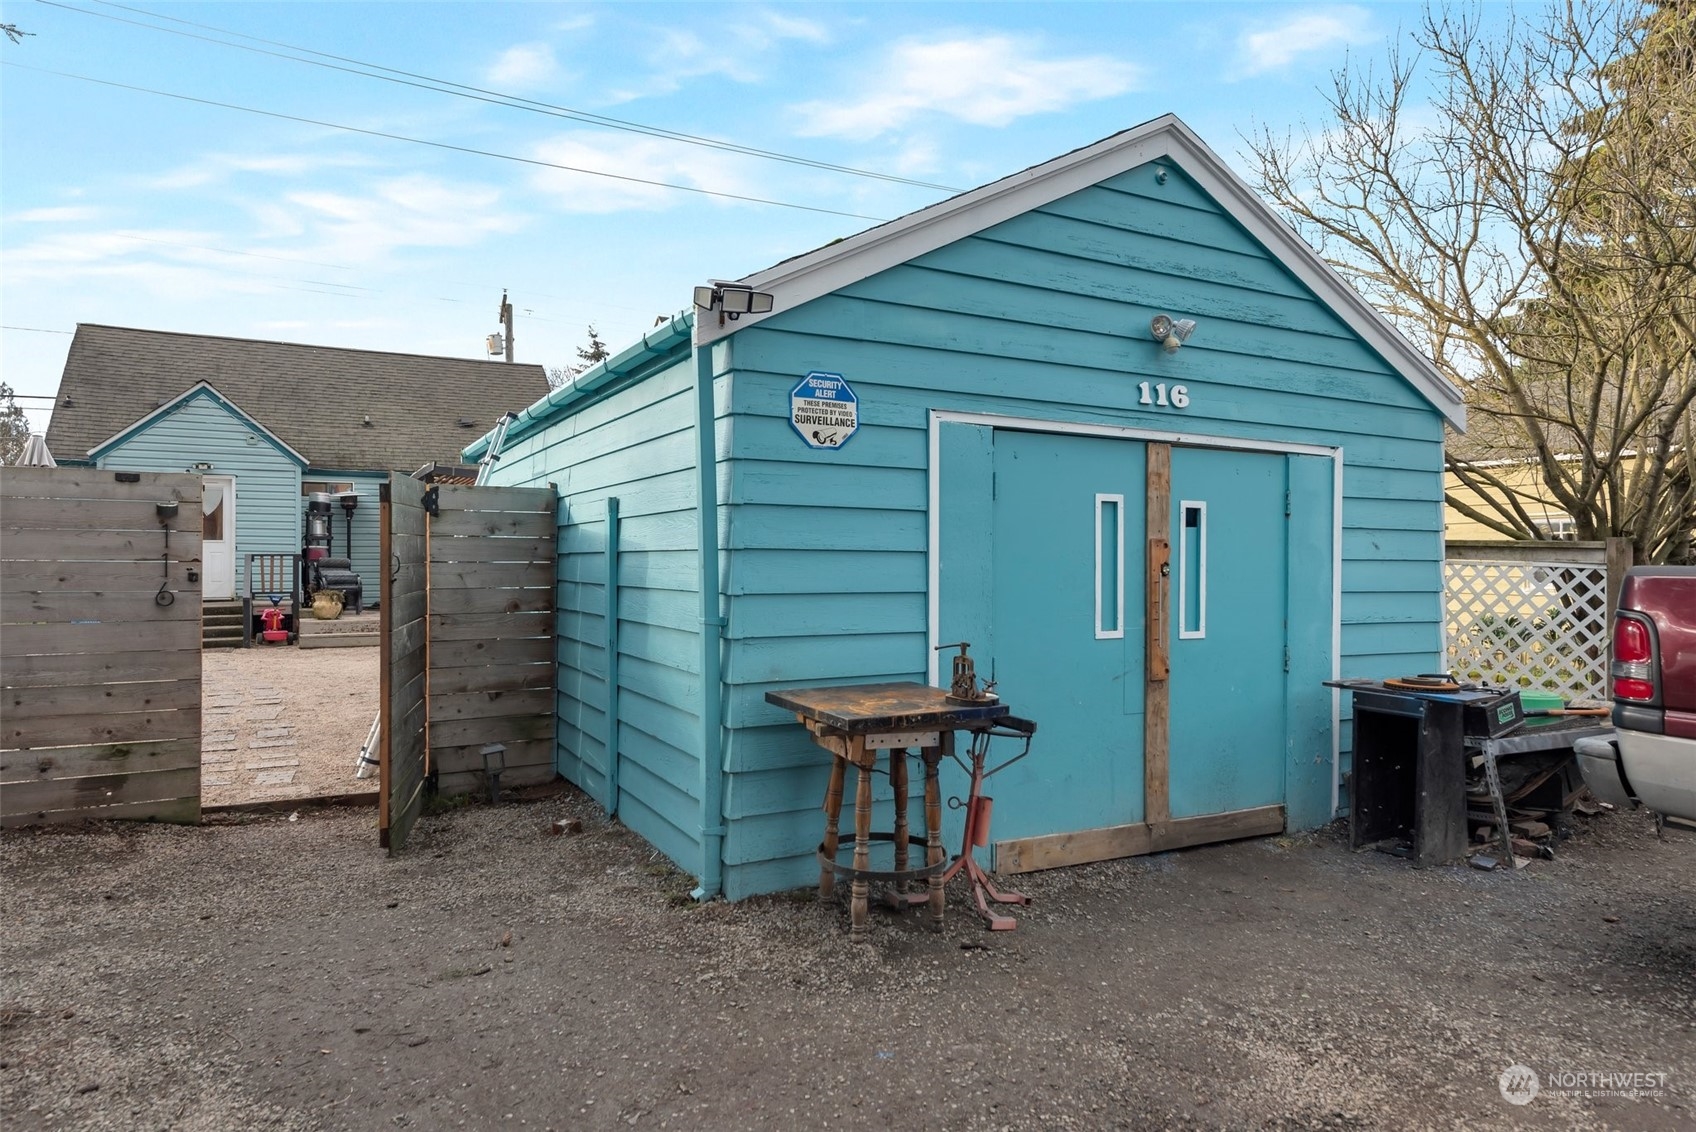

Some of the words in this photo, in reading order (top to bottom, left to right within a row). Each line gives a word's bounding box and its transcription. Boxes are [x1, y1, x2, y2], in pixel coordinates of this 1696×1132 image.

[808, 379, 842, 390] SECURITY
[815, 389, 837, 399] ALERT
[1138, 381, 1190, 408] 116
[821, 401, 847, 410] PREMISES
[797, 406, 828, 415] PROTECTED
[838, 410, 853, 418] VIDEO
[794, 414, 856, 428] SURVEILLANCE
